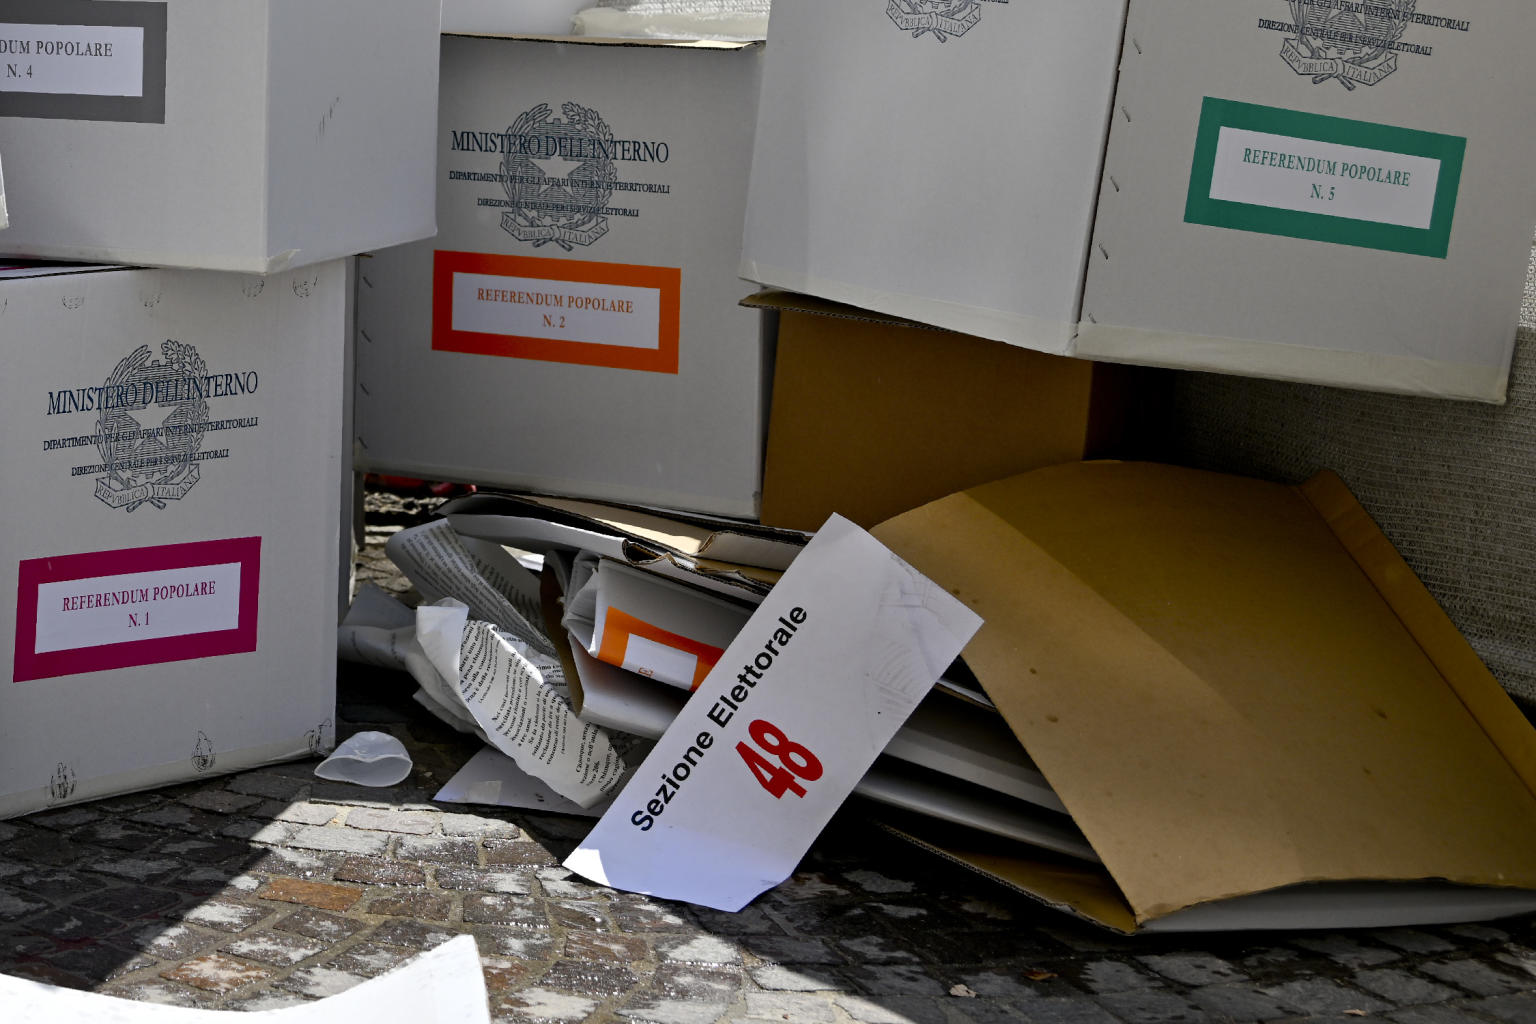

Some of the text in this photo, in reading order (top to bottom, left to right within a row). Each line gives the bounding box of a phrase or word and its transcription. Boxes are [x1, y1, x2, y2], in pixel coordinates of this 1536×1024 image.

[1333, 0, 1364, 14] AFFARI
[1410, 12, 1470, 32] TERRITORIALI
[35, 40, 113, 57] POPOLARE
[1258, 18, 1299, 35] DIREZIONE
[1387, 40, 1433, 56] ELETTORALI
[6, 64, 33, 79] N. 4
[451, 130, 669, 164] MINISTERO DELL'INTERNO
[449, 170, 508, 183] DIPARTIMENTO
[614, 181, 670, 194] TERRITORIALI
[1242, 147, 1411, 187] REFERENDUM POPOLARE
[1310, 183, 1335, 201] N. 5
[477, 287, 634, 314] REFERENDUM POPOLARE
[543, 314, 566, 328] N. 2
[46, 371, 259, 416] MINISTERO DELL'INTERNO
[43, 434, 104, 451] DIPARTIMENTO
[206, 416, 259, 432] TERRITORIALI
[71, 463, 110, 477] DIREZIONE
[189, 448, 230, 462] ELETTORALI
[62, 580, 216, 612] REFERENDUM POPOLARE
[127, 611, 150, 628] N. 1
[630, 606, 808, 832] Sezione Elettorale
[735, 719, 824, 799] 48
